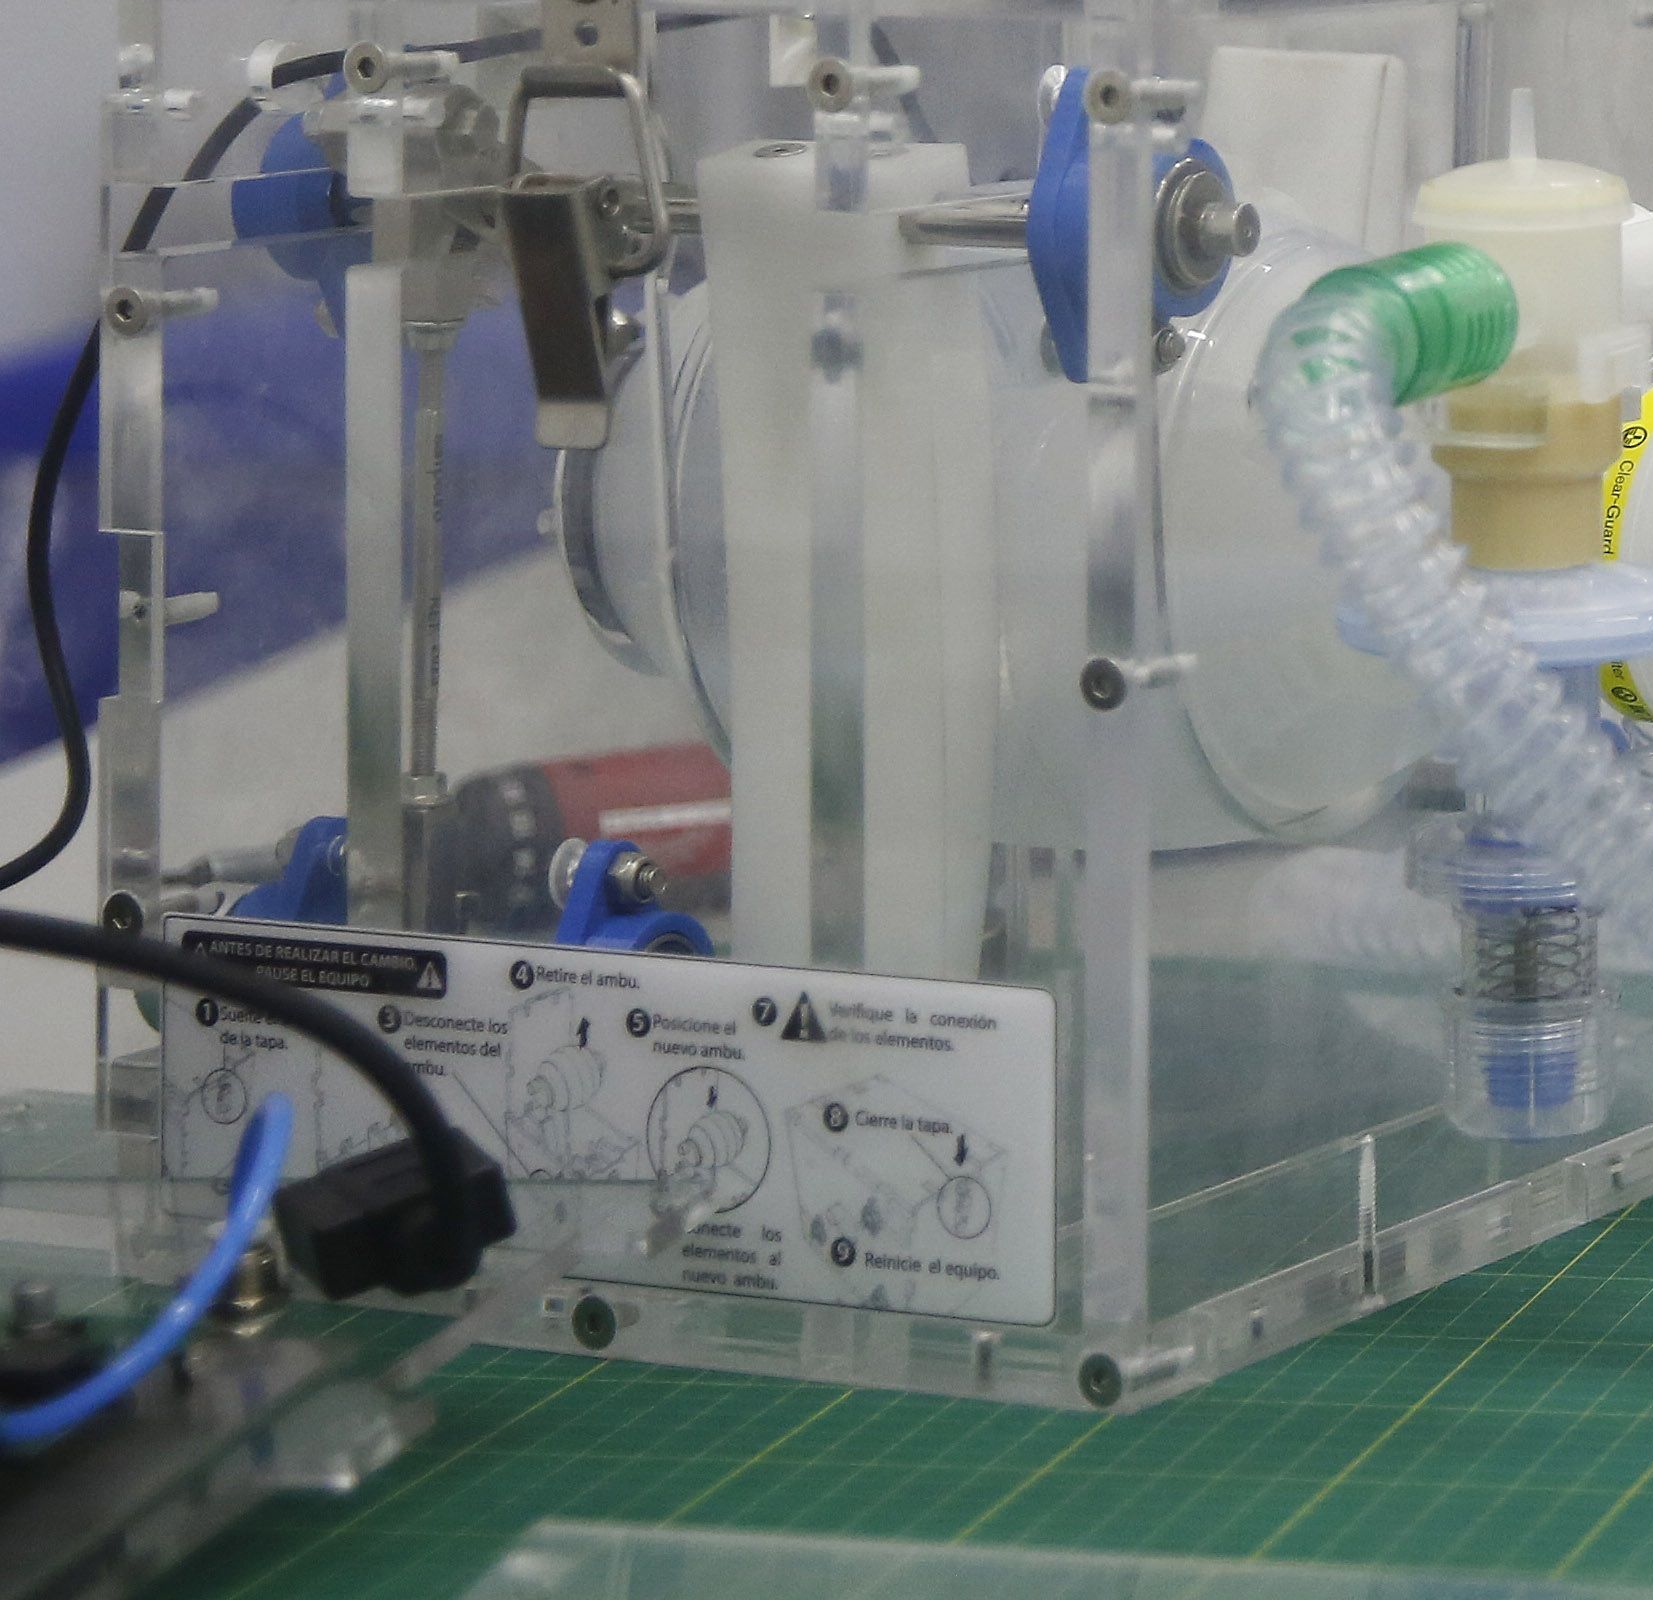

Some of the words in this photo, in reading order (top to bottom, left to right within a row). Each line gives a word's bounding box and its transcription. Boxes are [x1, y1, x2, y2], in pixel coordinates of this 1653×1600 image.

[1603, 460, 1634, 555] Clear-Guard
[208, 940, 251, 957] ANTES
[255, 944, 273, 959] DE
[276, 946, 339, 964] REALIZAR
[343, 950, 357, 966] EL
[301, 968, 315, 983] EL
[319, 970, 370, 988] EQUIPO
[536, 966, 577, 984] Retire
[580, 970, 592, 986] el
[596, 972, 640, 989] ambu.
[400, 1010, 484, 1032] Desconecte
[489, 1017, 508, 1035] los
[651, 1013, 719, 1034] Posicione
[724, 1020, 736, 1036] el
[905, 1007, 918, 1024] la
[930, 1012, 997, 1030] conexión
[220, 1031, 238, 1045] de
[241, 1031, 252, 1047] la
[256, 1034, 288, 1051] tapa.
[404, 1035, 476, 1055] elementos
[480, 1041, 501, 1057] del
[653, 1041, 697, 1057] nuevo
[701, 1044, 746, 1061] ambu.
[875, 1030, 955, 1052] elementos.
[406, 1059, 448, 1077] mbu.
[855, 1109, 897, 1129] Cierre
[901, 1114, 914, 1131] la
[917, 1117, 953, 1136] tapa.
[762, 1225, 782, 1242] los
[682, 1243, 757, 1264] elementos
[769, 1251, 781, 1266] al
[682, 1270, 727, 1285] nuevo
[864, 1252, 922, 1272] Reinicie
[928, 1258, 941, 1274] el
[946, 1262, 1000, 1282] equipo.
